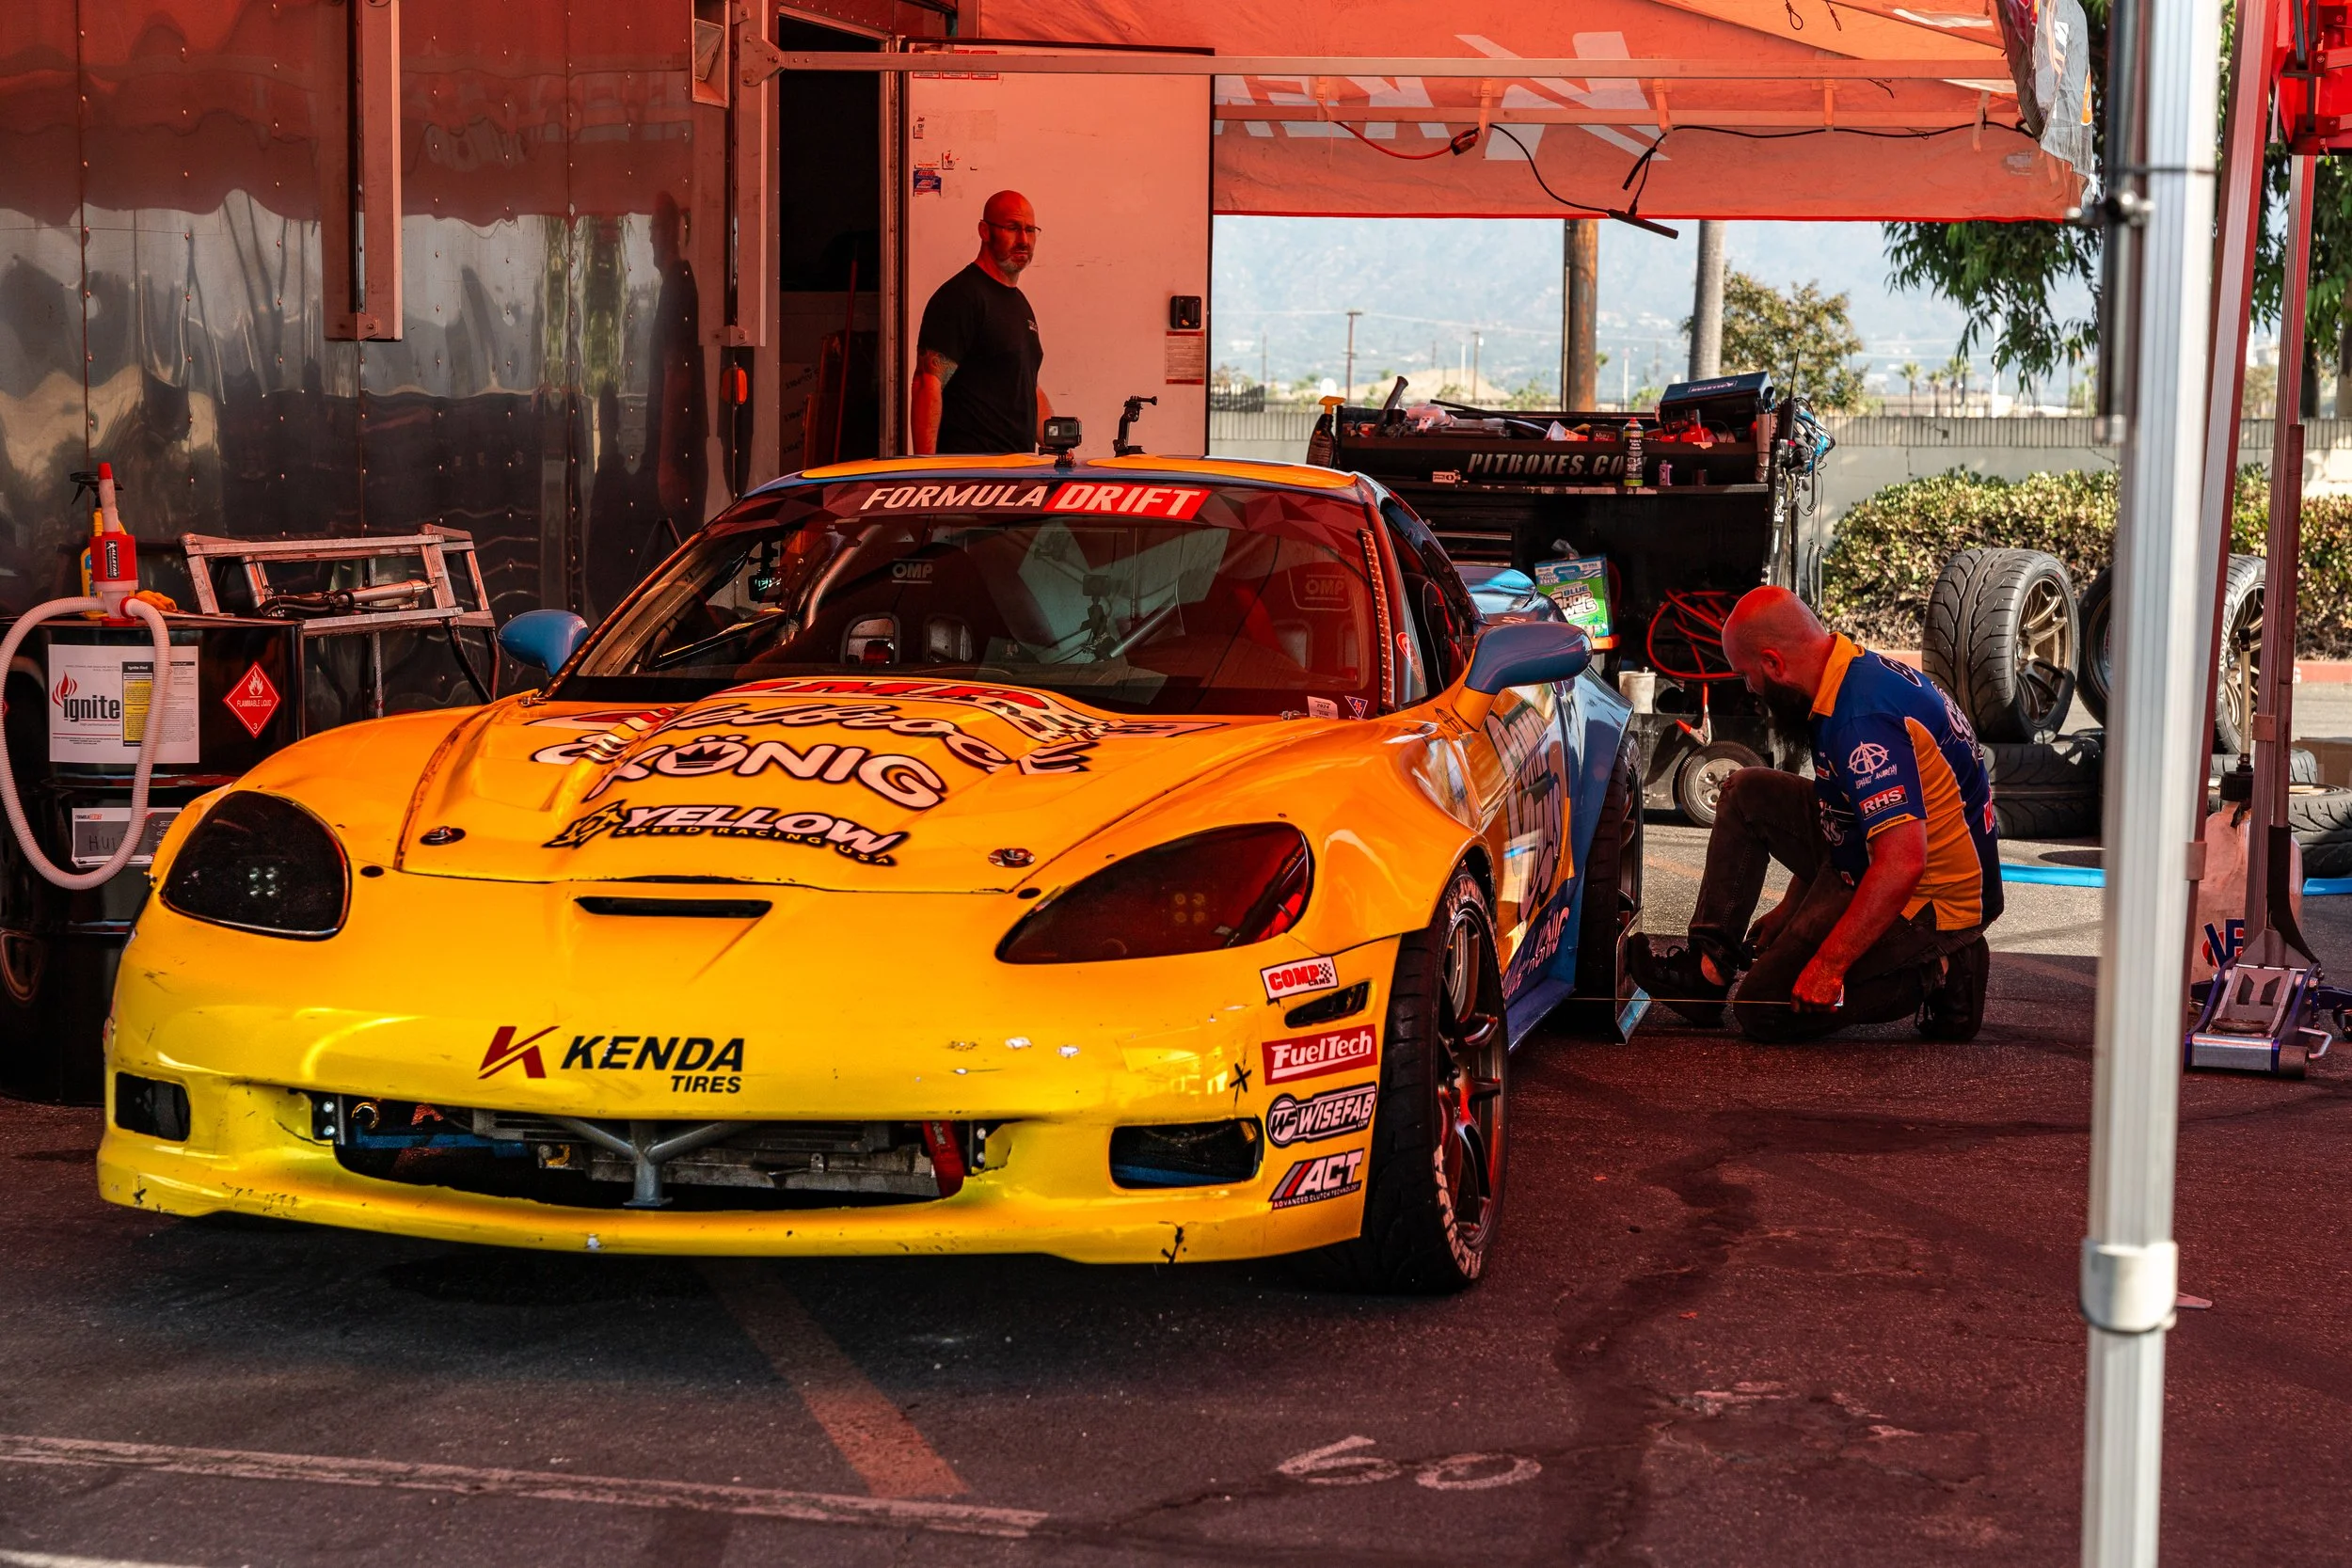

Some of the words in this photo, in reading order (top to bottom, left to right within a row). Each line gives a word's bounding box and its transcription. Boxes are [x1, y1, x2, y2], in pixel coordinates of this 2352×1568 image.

[1467, 452, 1647, 476] PITBOXES.CO
[860, 484, 1049, 511] FORMULA
[1054, 484, 1201, 516] DRIFT
[893, 562, 933, 578] OMP
[1305, 578, 1345, 595] OMP
[1563, 585, 1589, 596] BLUE
[63, 694, 120, 722] ignite
[236, 699, 261, 707] FLAMMABLE
[261, 699, 272, 707] LIQUID
[581, 735, 946, 810] KÖNIG
[1863, 789, 1903, 815] RHS
[623, 805, 902, 854] YELLOW
[616, 826, 701, 835] SPEED
[720, 827, 822, 846] RACING
[838, 844, 890, 864] USA
[1267, 964, 1321, 990] COMP
[1308, 977, 1331, 987] CAMS
[560, 1035, 745, 1072] KENDA
[1270, 1030, 1373, 1069] FuelTech
[670, 1075, 743, 1094] TIRES
[1298, 1092, 1375, 1134] WISEFAB
[1295, 1149, 1364, 1196] ACT
[1273, 1196, 1309, 1209] ADVANCED
[1309, 1191, 1330, 1201] CLUTCH
